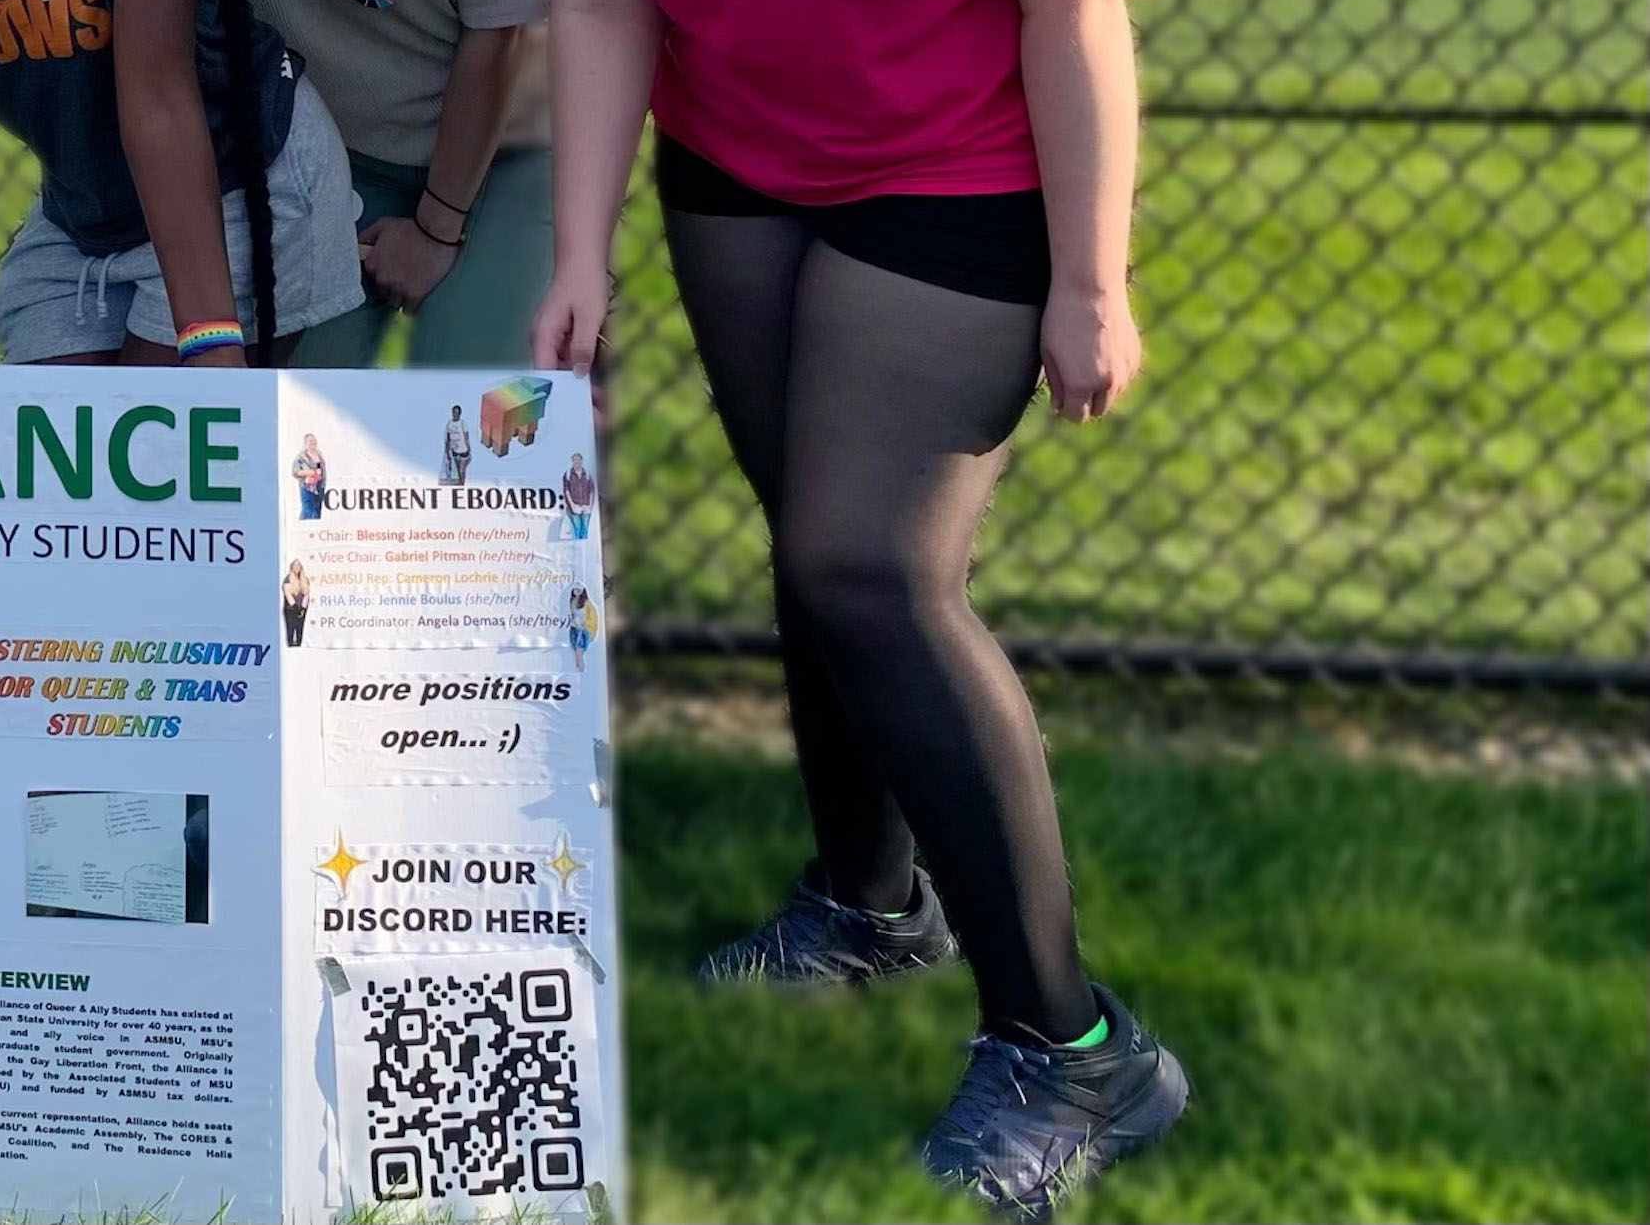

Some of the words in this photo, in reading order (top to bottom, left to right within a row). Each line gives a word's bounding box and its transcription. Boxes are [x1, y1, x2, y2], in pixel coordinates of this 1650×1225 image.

[324, 487, 441, 511] CURRENT
[452, 487, 565, 510] EBOARD:
[32, 523, 246, 565] STUDENTS
[318, 529, 353, 542] Chair:
[357, 529, 405, 543] Blessing
[408, 529, 455, 541] Jackson
[458, 529, 530, 543] (they/them)
[318, 551, 345, 563] Vice
[347, 551, 382, 563] Chair:
[385, 550, 429, 562] Gabriel
[432, 550, 476, 562] Pitman
[478, 550, 535, 564] (he/they)
[319, 573, 364, 585] ASMSU
[366, 573, 393, 586] Rep:
[396, 572, 451, 584] Cameron
[455, 572, 499, 583] Lochrie
[502, 572, 575, 585] (they/them)
[320, 595, 346, 607] RHA
[349, 595, 376, 608] Rep:
[378, 594, 417, 606] Jennie
[420, 593, 462, 605] Boulus
[465, 592, 520, 607] (she/her)
[320, 616, 338, 628] PR
[340, 615, 414, 628] Coordinator:
[417, 614, 460, 629] Angela
[463, 614, 506, 627] Demas
[508, 614, 571, 629] (she/they)
[109, 640, 271, 668] INCLUSIVITY
[41, 675, 130, 703] QUEER
[134, 678, 155, 702] &
[164, 676, 248, 704] TRANS
[330, 679, 411, 702] more
[420, 675, 571, 706] positions
[46, 712, 182, 739] STUDENTS
[380, 727, 488, 755] open...
[498, 723, 522, 754] ;)
[372, 859, 451, 885] JOIN
[463, 859, 537, 885] OUR
[323, 907, 473, 933] DISCORD
[486, 909, 587, 936] HERE:
[45, 1003, 76, 1011] Queer
[89, 1006, 109, 1016] Ally
[111, 1007, 157, 1016] Students
[160, 1009, 178, 1017] has
[181, 1011, 220, 1019] existed
[16, 1015, 44, 1023] State
[48, 1017, 100, 1029] University
[104, 1020, 118, 1028] for
[165, 1025, 197, 1033] years,
[43, 1031, 62, 1040] ally
[77, 1033, 105, 1041] voice
[144, 1036, 186, 1046] ASMSU,
[201, 1039, 233, 1047] MSU's
[54, 1046, 93, 1054] student
[105, 1049, 170, 1058] government.
[183, 1051, 234, 1062] Originally
[30, 1057, 50, 1067] Gay
[56, 1059, 108, 1068] Liberation
[115, 1062, 145, 1072] Front,
[175, 1065, 218, 1074] Alliance
[224, 1067, 233, 1075] is
